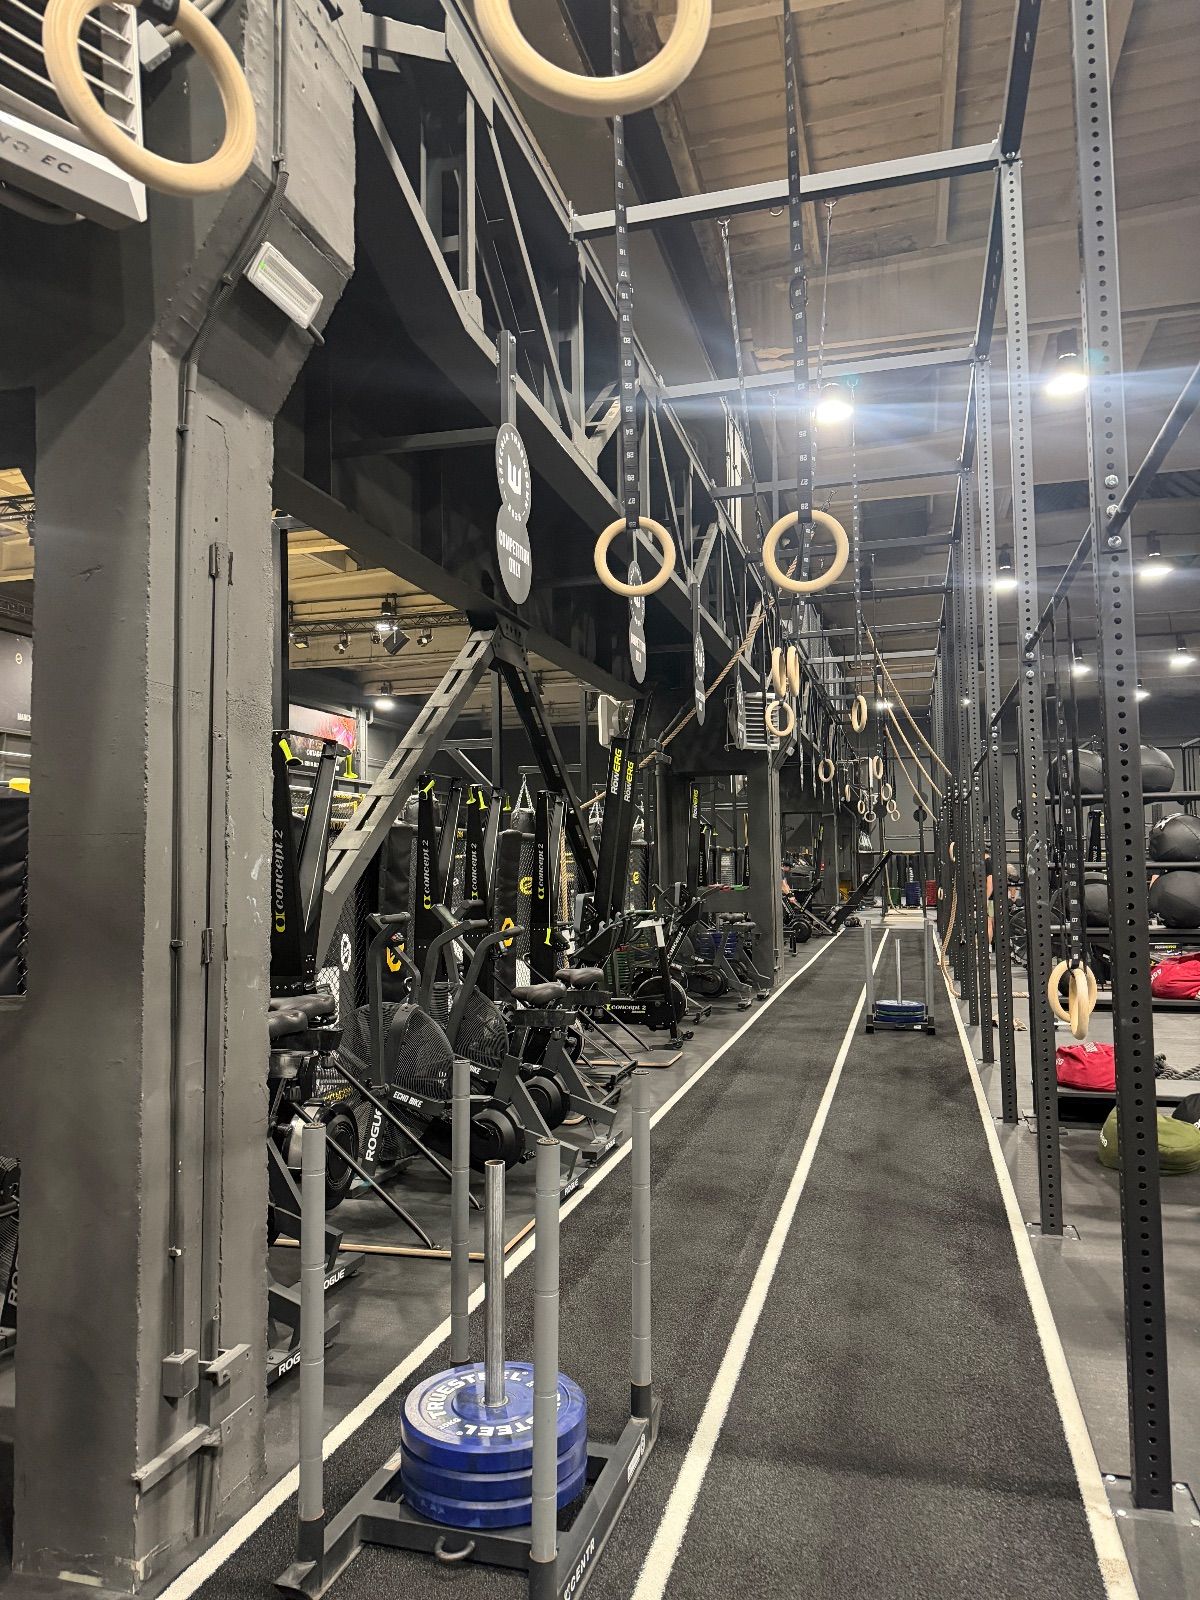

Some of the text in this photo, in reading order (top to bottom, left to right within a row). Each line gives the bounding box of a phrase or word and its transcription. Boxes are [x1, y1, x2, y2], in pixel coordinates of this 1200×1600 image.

[41, 155, 73, 174] EC
[273, 829, 285, 910] concept 2
[421, 839, 431, 894] concept 2
[470, 850, 478, 891] concept
[537, 850, 545, 887] concept
[393, 1090, 424, 1109] ECHO BIKE
[323, 1268, 346, 1290] OGUE
[278, 1352, 301, 1377] ROG
